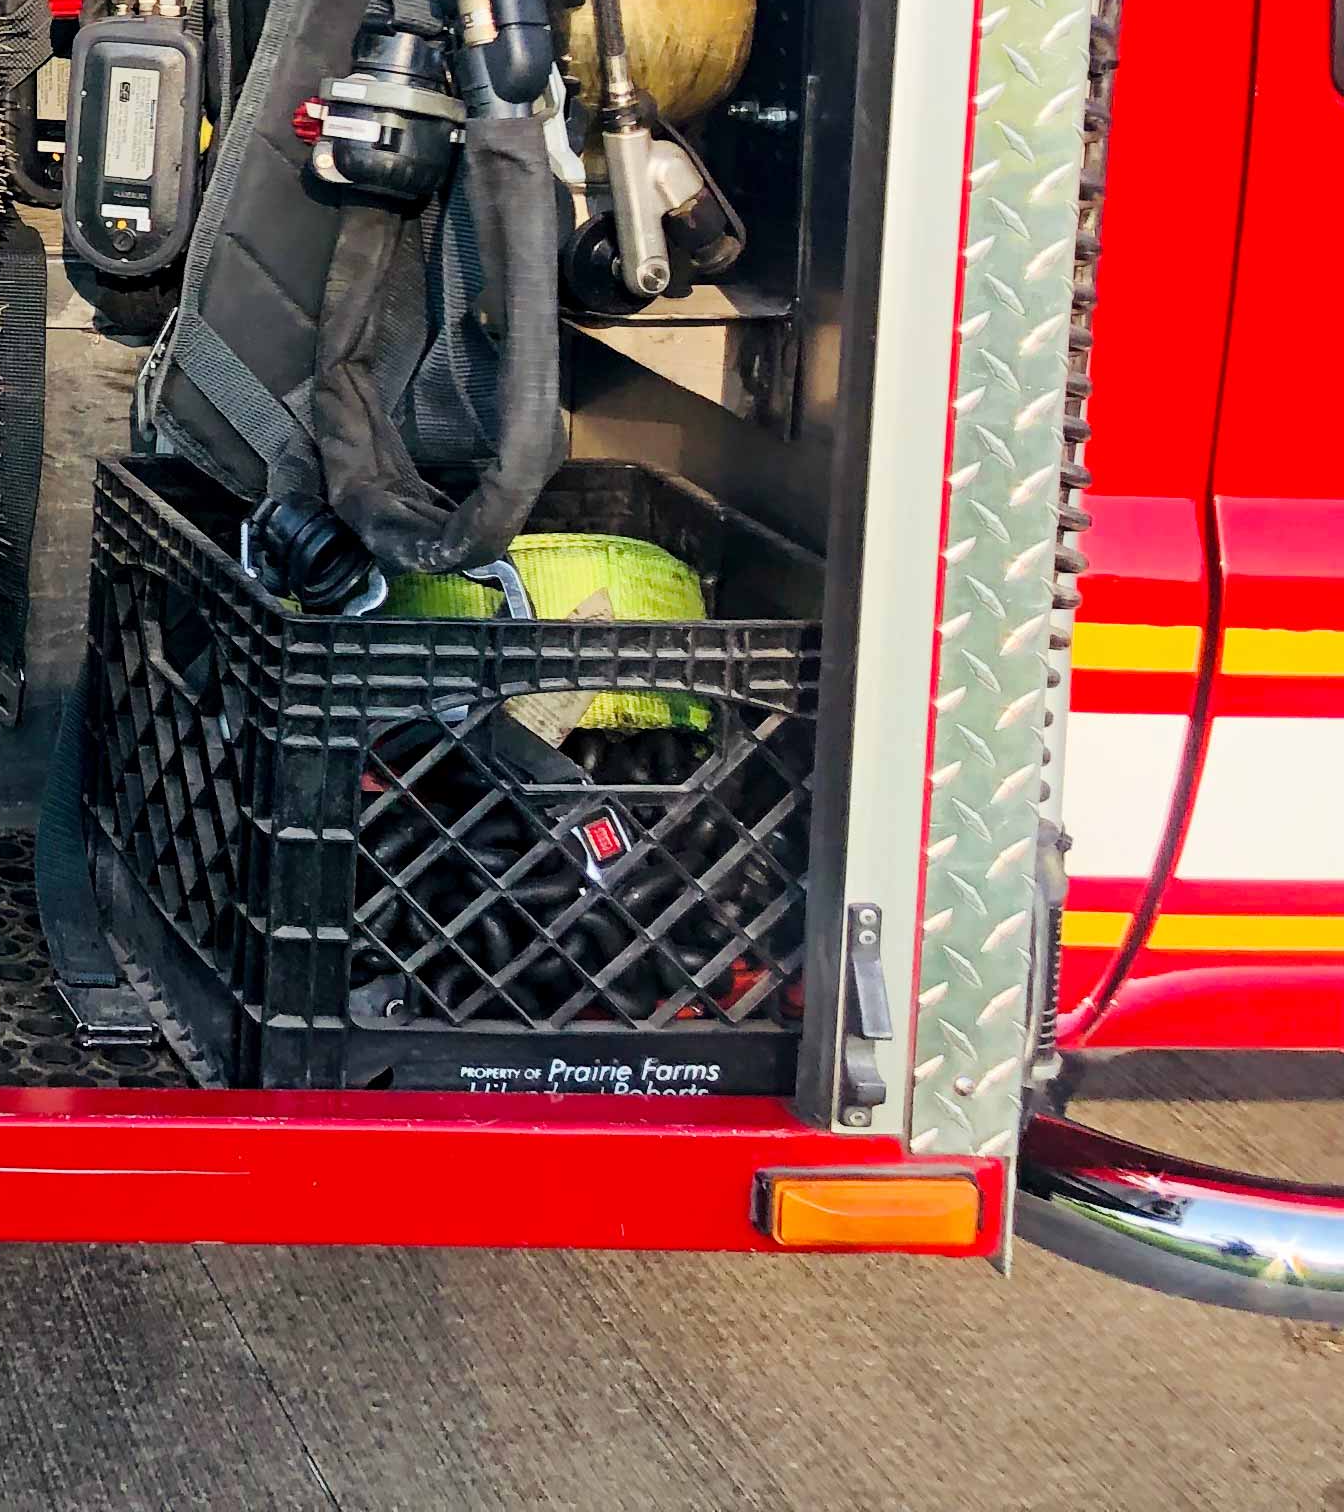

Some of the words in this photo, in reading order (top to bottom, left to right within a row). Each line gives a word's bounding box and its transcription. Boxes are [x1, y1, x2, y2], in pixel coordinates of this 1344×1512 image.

[460, 1066, 521, 1079] PROPERTY
[523, 1068, 543, 1080] OF
[548, 1057, 633, 1082] Prairie
[640, 1056, 721, 1082] Farms
